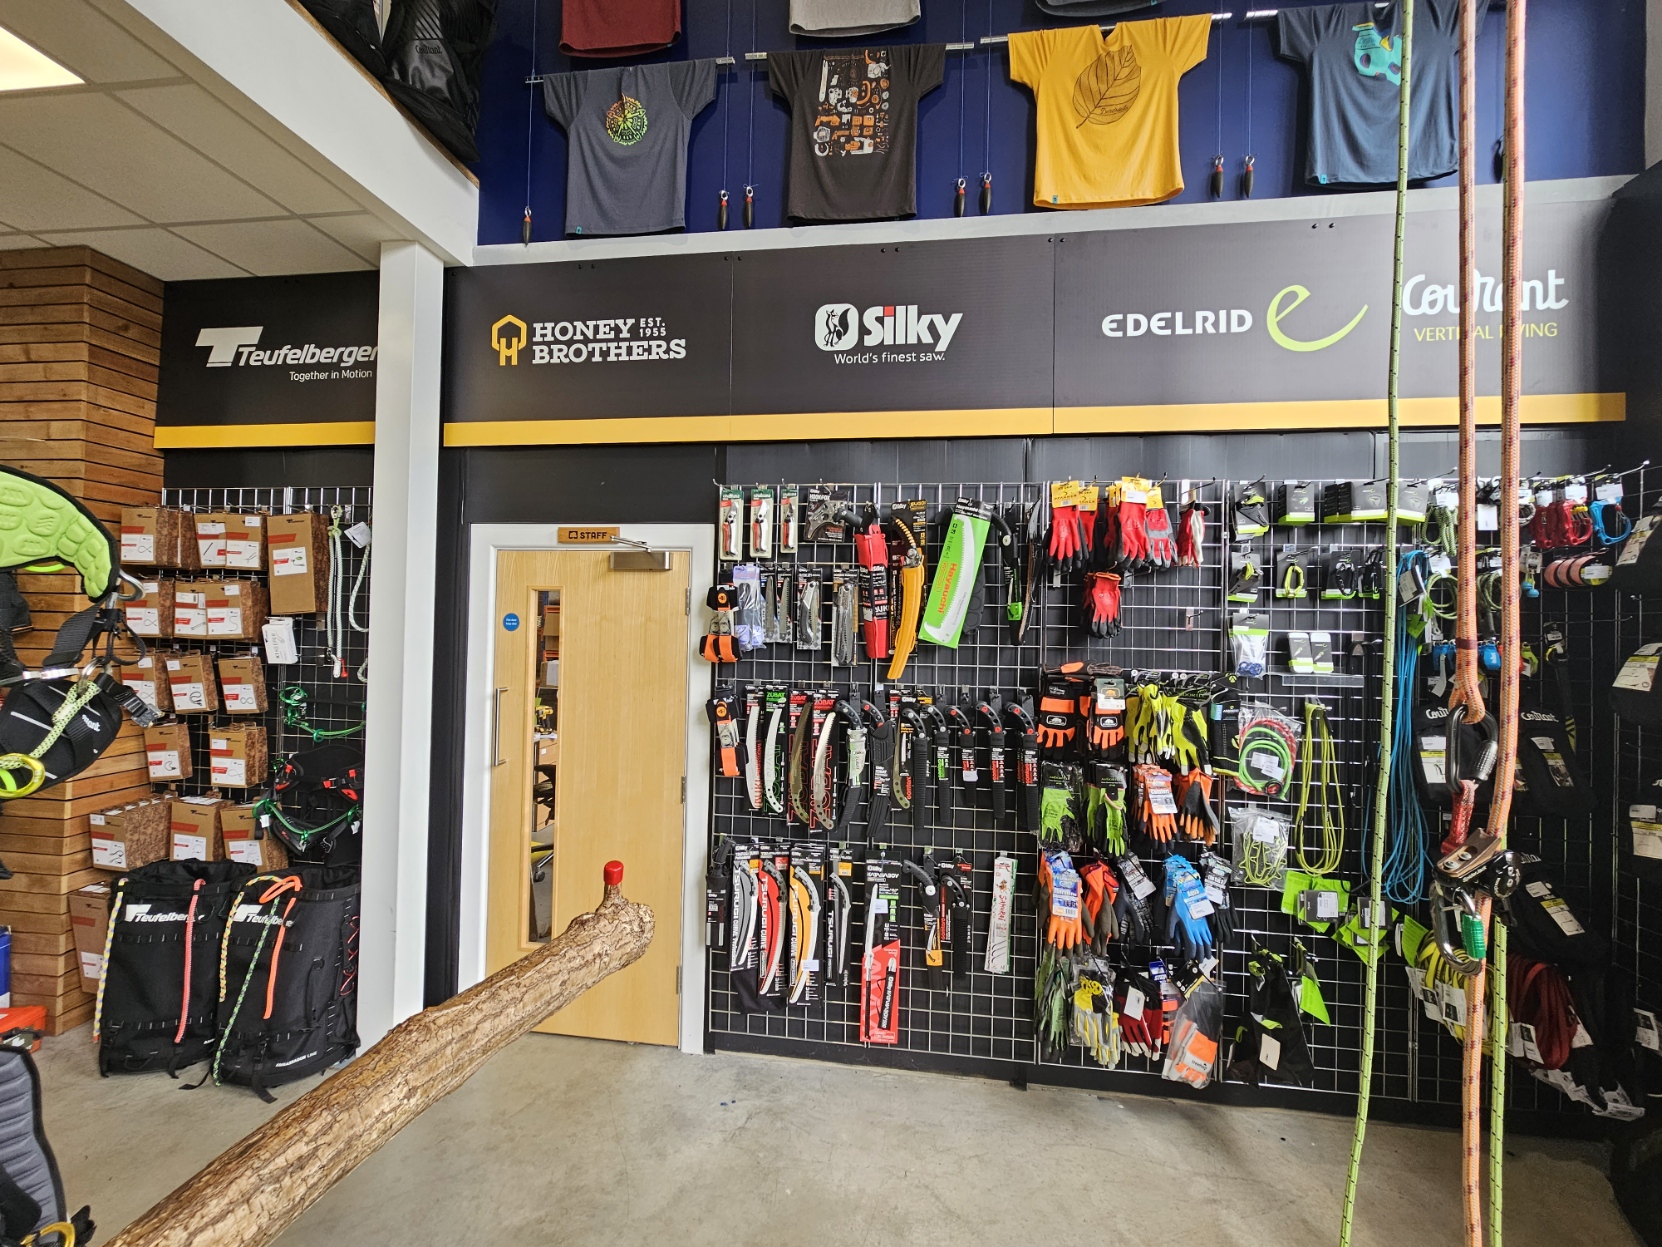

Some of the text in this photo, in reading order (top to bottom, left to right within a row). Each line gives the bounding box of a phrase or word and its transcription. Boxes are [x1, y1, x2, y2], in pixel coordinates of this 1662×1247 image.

[532, 318, 636, 342] HONEY
[640, 317, 666, 328] EST.
[640, 328, 667, 338] 1955
[862, 304, 964, 352] Silky
[1101, 309, 1253, 337] EDELRID
[1413, 325, 1494, 342] VERTIAL
[238, 343, 379, 367] Teufelberger
[532, 338, 687, 364] BROTHERS
[834, 352, 946, 364] World's finest saw.
[289, 369, 373, 382] Together in Motion
[579, 531, 608, 540] STAFF
[938, 563, 957, 614] Hayauchi
[732, 868, 741, 919] TSURUGI
[135, 912, 204, 923] Teufelber
[791, 882, 799, 935] TSURUGI
[790, 937, 798, 957] CURVE
